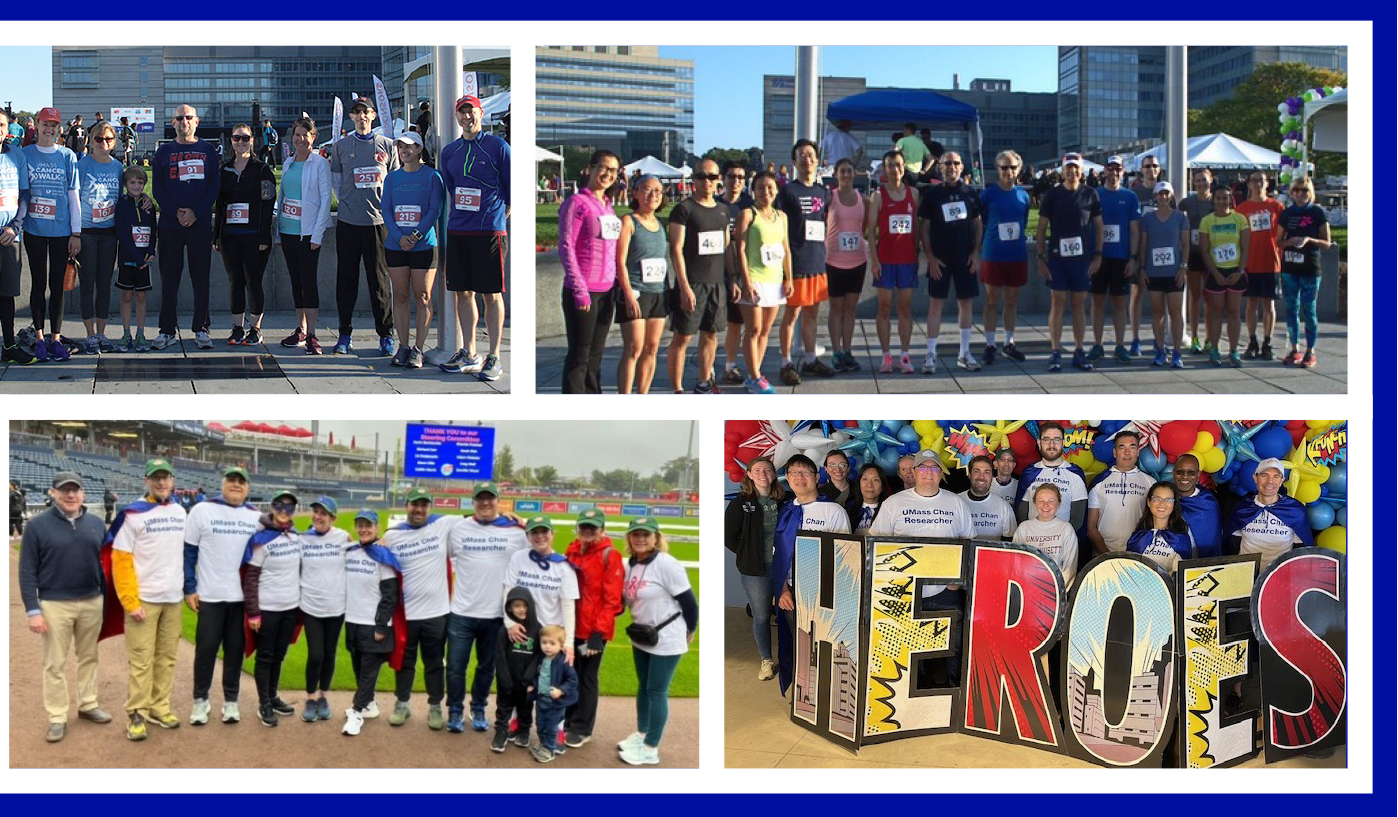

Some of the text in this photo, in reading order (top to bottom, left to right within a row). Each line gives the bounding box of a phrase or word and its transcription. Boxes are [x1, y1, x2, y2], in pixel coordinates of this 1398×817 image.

[359, 174, 375, 182] 251
[460, 196, 472, 204] 95
[34, 205, 50, 214] 139
[98, 208, 111, 218] 167
[284, 206, 296, 214] 120
[399, 212, 416, 220] 215
[1007, 228, 1014, 238] 9
[1063, 242, 1080, 252] 160
[1155, 254, 1172, 262] 202
[144, 518, 168, 526] UMass
[238, 520, 256, 529] Chan
[806, 518, 825, 526] Chan
[904, 517, 953, 525] Researcher
[212, 528, 254, 536] Researcher
[1242, 527, 1288, 536] Researcher
[1026, 534, 1061, 542] UNIVERSITY
[396, 535, 439, 552] UMass Chan
[400, 544, 440, 558] Researcher
[1144, 549, 1170, 558] archer
[362, 559, 376, 567] Chan
[542, 574, 562, 583] Chan
[516, 579, 560, 591] Researcher
[793, 535, 1346, 768] HEROES
